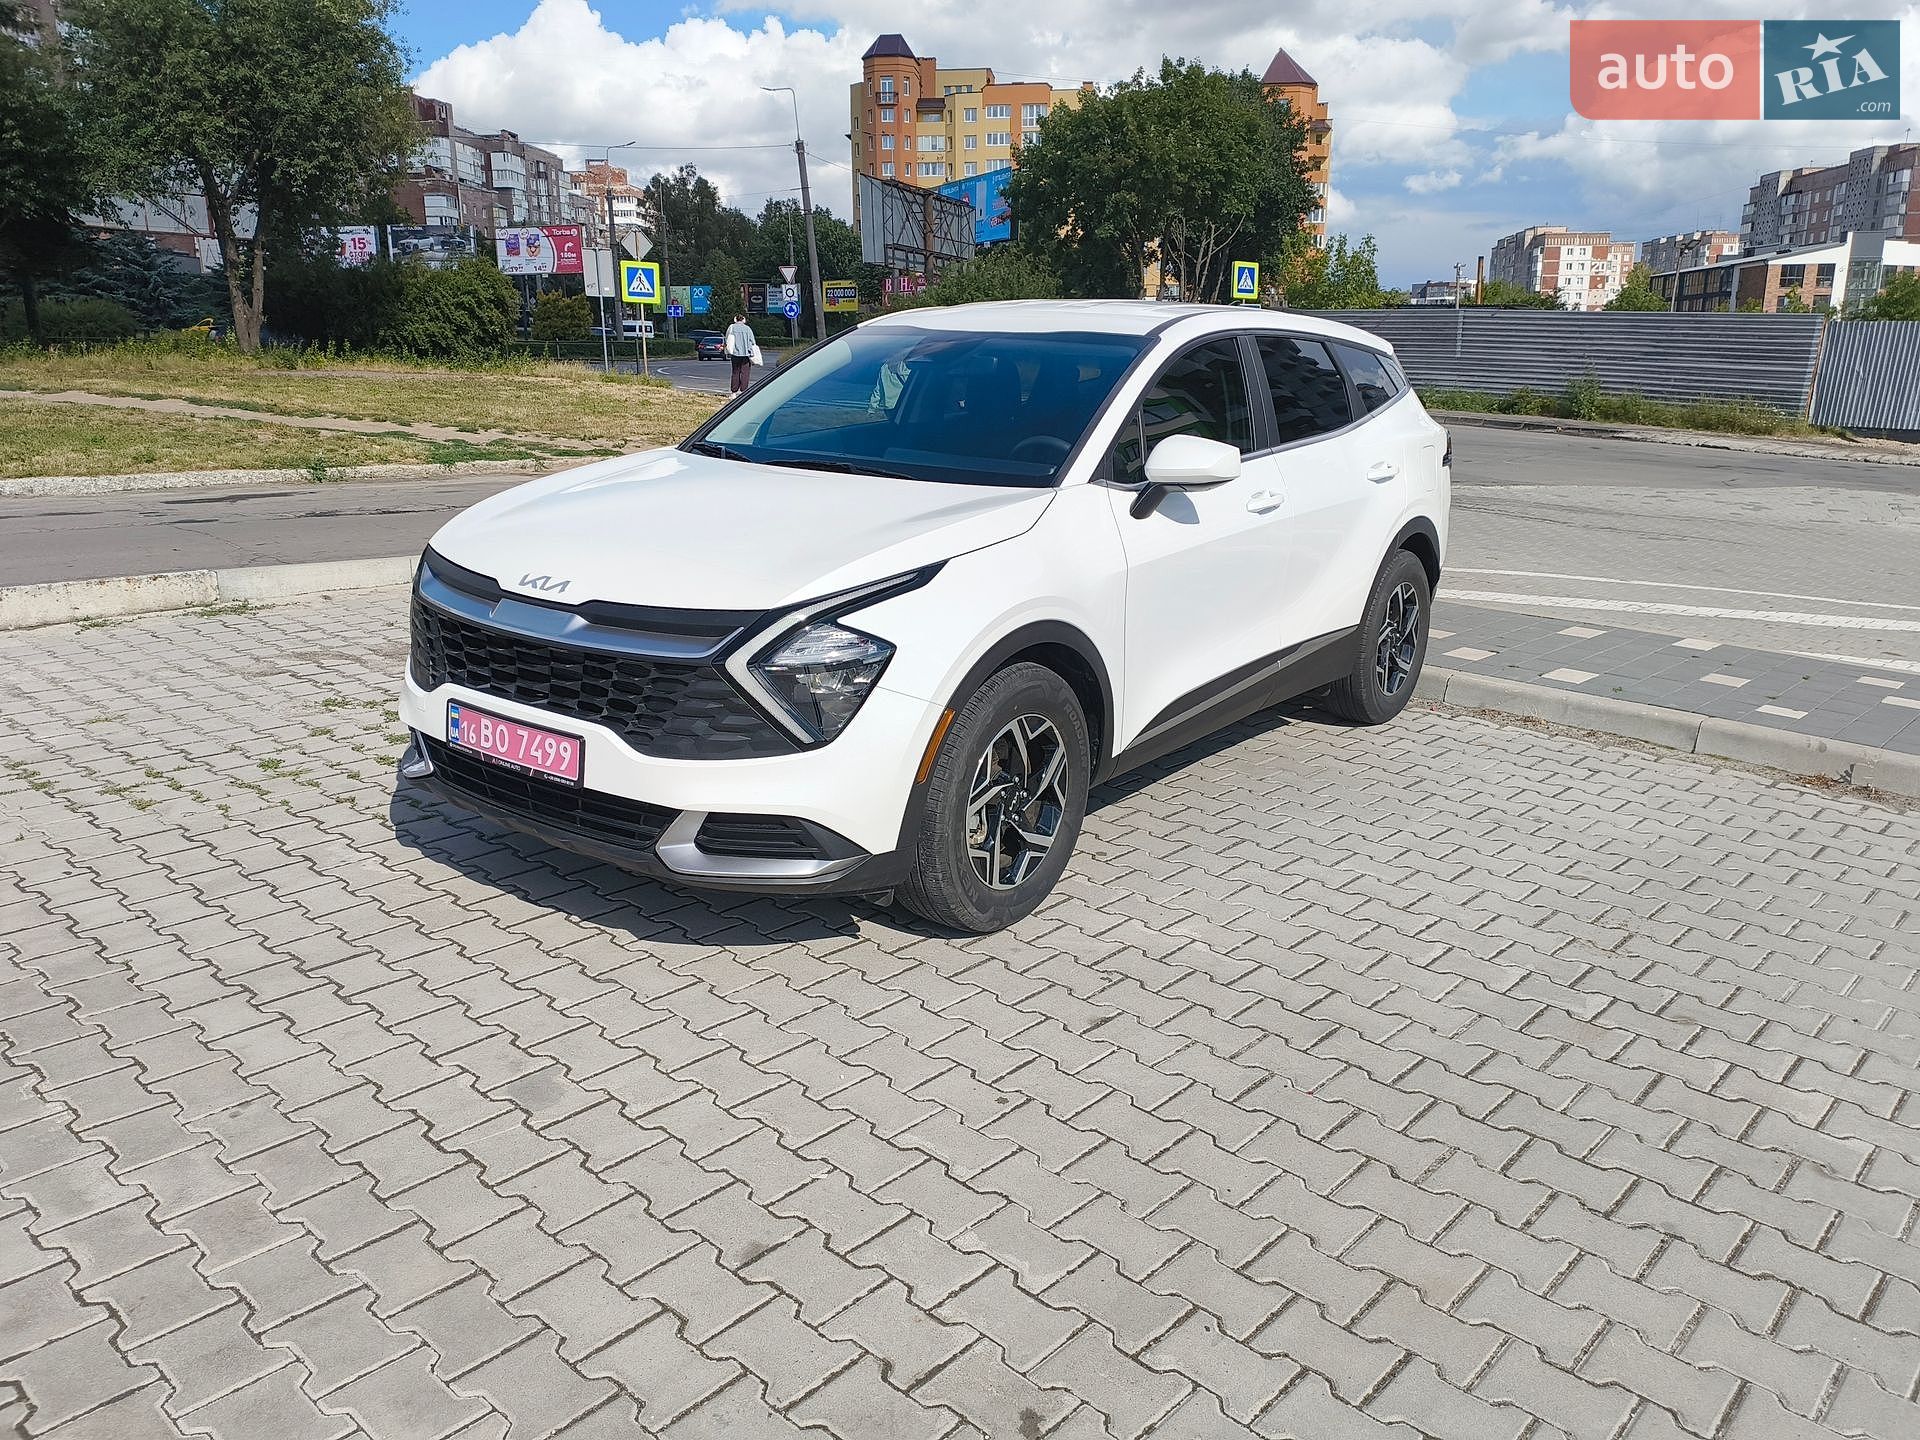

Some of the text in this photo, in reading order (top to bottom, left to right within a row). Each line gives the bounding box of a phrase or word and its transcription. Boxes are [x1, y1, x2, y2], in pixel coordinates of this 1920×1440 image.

[518, 573, 571, 593] KIA
[450, 726, 460, 739] UA
[461, 717, 572, 771] 16 BO 7499
